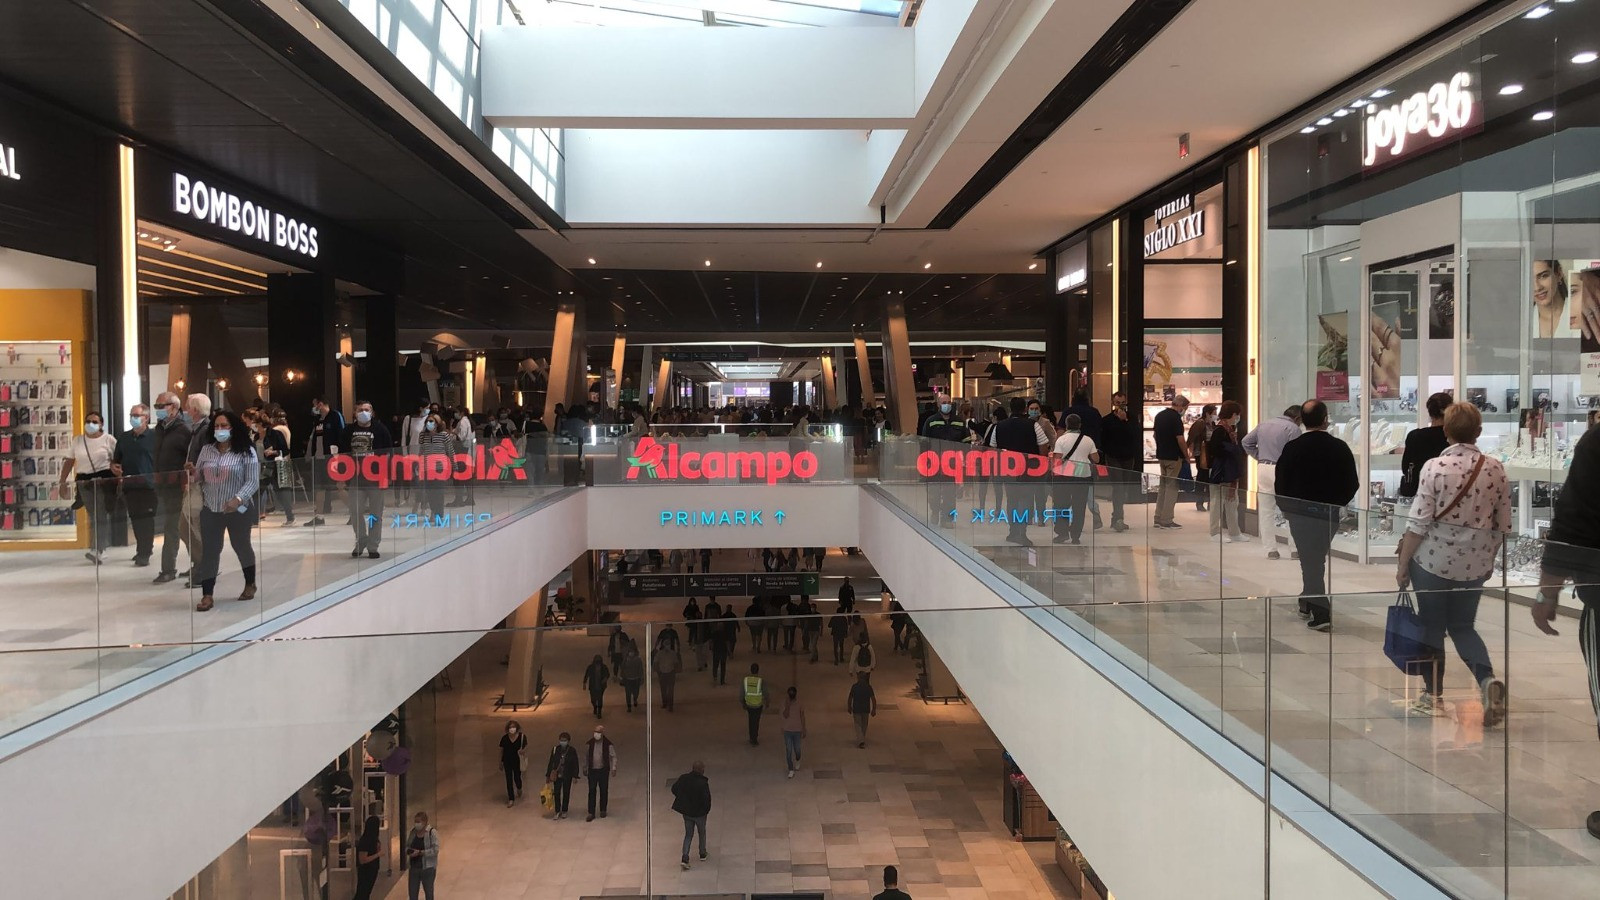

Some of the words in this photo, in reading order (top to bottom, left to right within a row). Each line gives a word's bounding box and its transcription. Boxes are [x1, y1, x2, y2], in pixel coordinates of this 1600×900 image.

[1364, 72, 1473, 166] joya36
[173, 172, 270, 242] BOMBON
[274, 213, 319, 258] BOSS
[1144, 222, 1176, 257] SIGLO
[1176, 209, 1203, 244] XXI
[626, 437, 818, 485] Alcampo
[661, 510, 763, 526] PRIMARK
